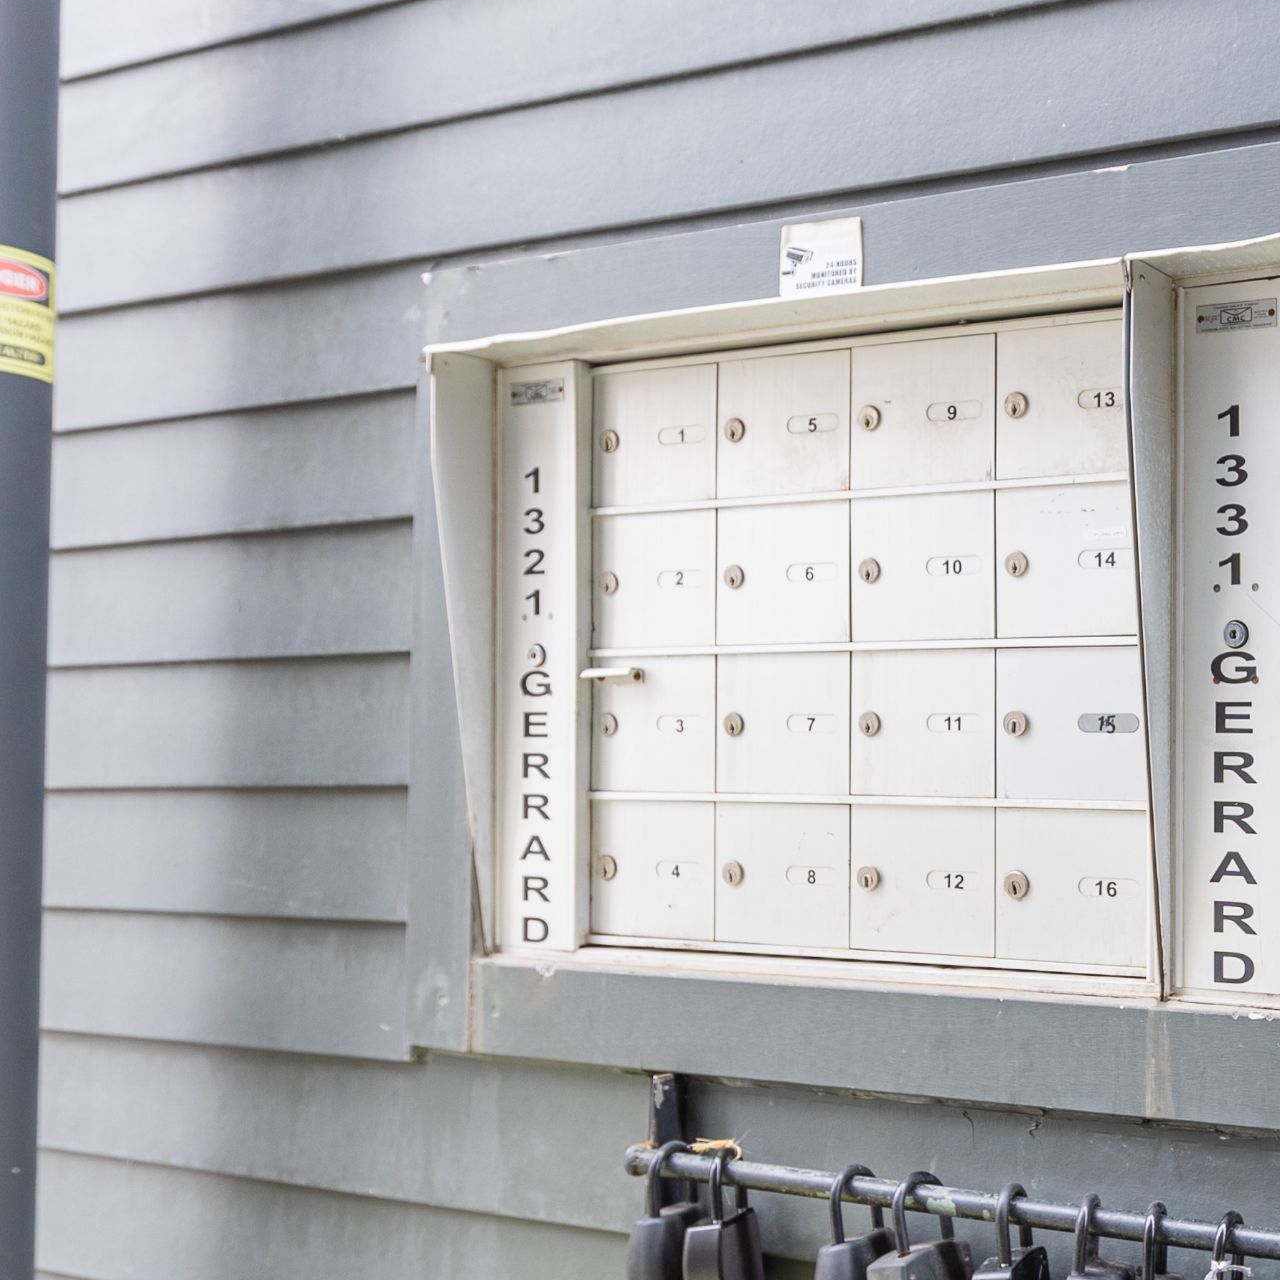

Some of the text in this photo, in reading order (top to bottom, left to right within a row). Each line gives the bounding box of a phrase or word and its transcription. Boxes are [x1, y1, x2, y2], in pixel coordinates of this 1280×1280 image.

[826, 258, 857, 269] 24 HOURS
[811, 267, 857, 279] MONITORED BY
[796, 276, 857, 290] SECURITY CAMERAS
[1093, 391, 1115, 408] 13
[947, 405, 957, 421] 9
[808, 417, 816, 432] 5
[943, 559, 962, 575] 10
[1094, 551, 1116, 568] 14
[676, 571, 684, 586] 2
[805, 566, 814, 581] 6
[1210, 404, 1259, 984] 1331 GERRARD
[520, 466, 553, 944] 1321 GERRARD
[676, 718, 684, 733] 3
[807, 717, 816, 731] 7
[944, 716, 961, 731] 11
[671, 864, 680, 879] 4
[807, 869, 816, 885] 8
[944, 873, 964, 890] 12
[1095, 880, 1117, 898] 16
